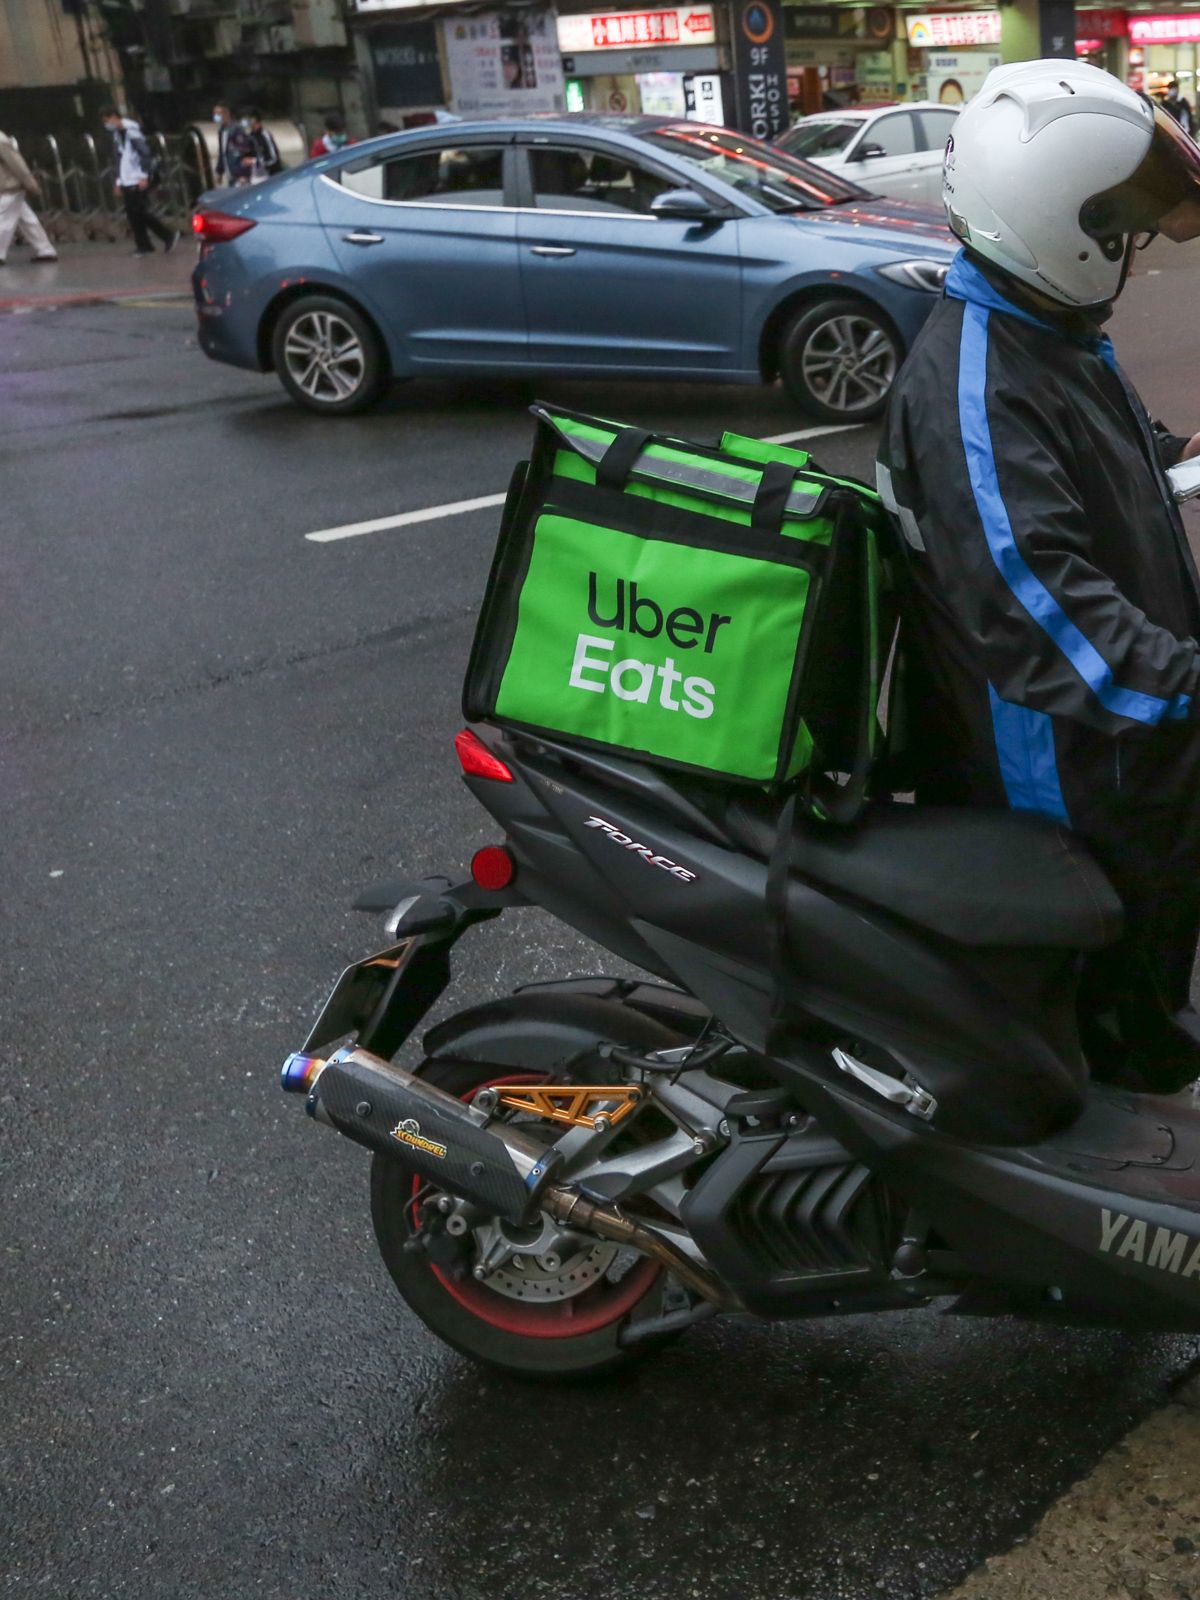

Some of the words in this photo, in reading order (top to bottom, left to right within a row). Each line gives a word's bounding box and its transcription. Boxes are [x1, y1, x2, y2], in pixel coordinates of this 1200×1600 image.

[750, 47, 768, 66] 9F
[587, 571, 732, 654] Uber
[568, 633, 716, 719] Eats
